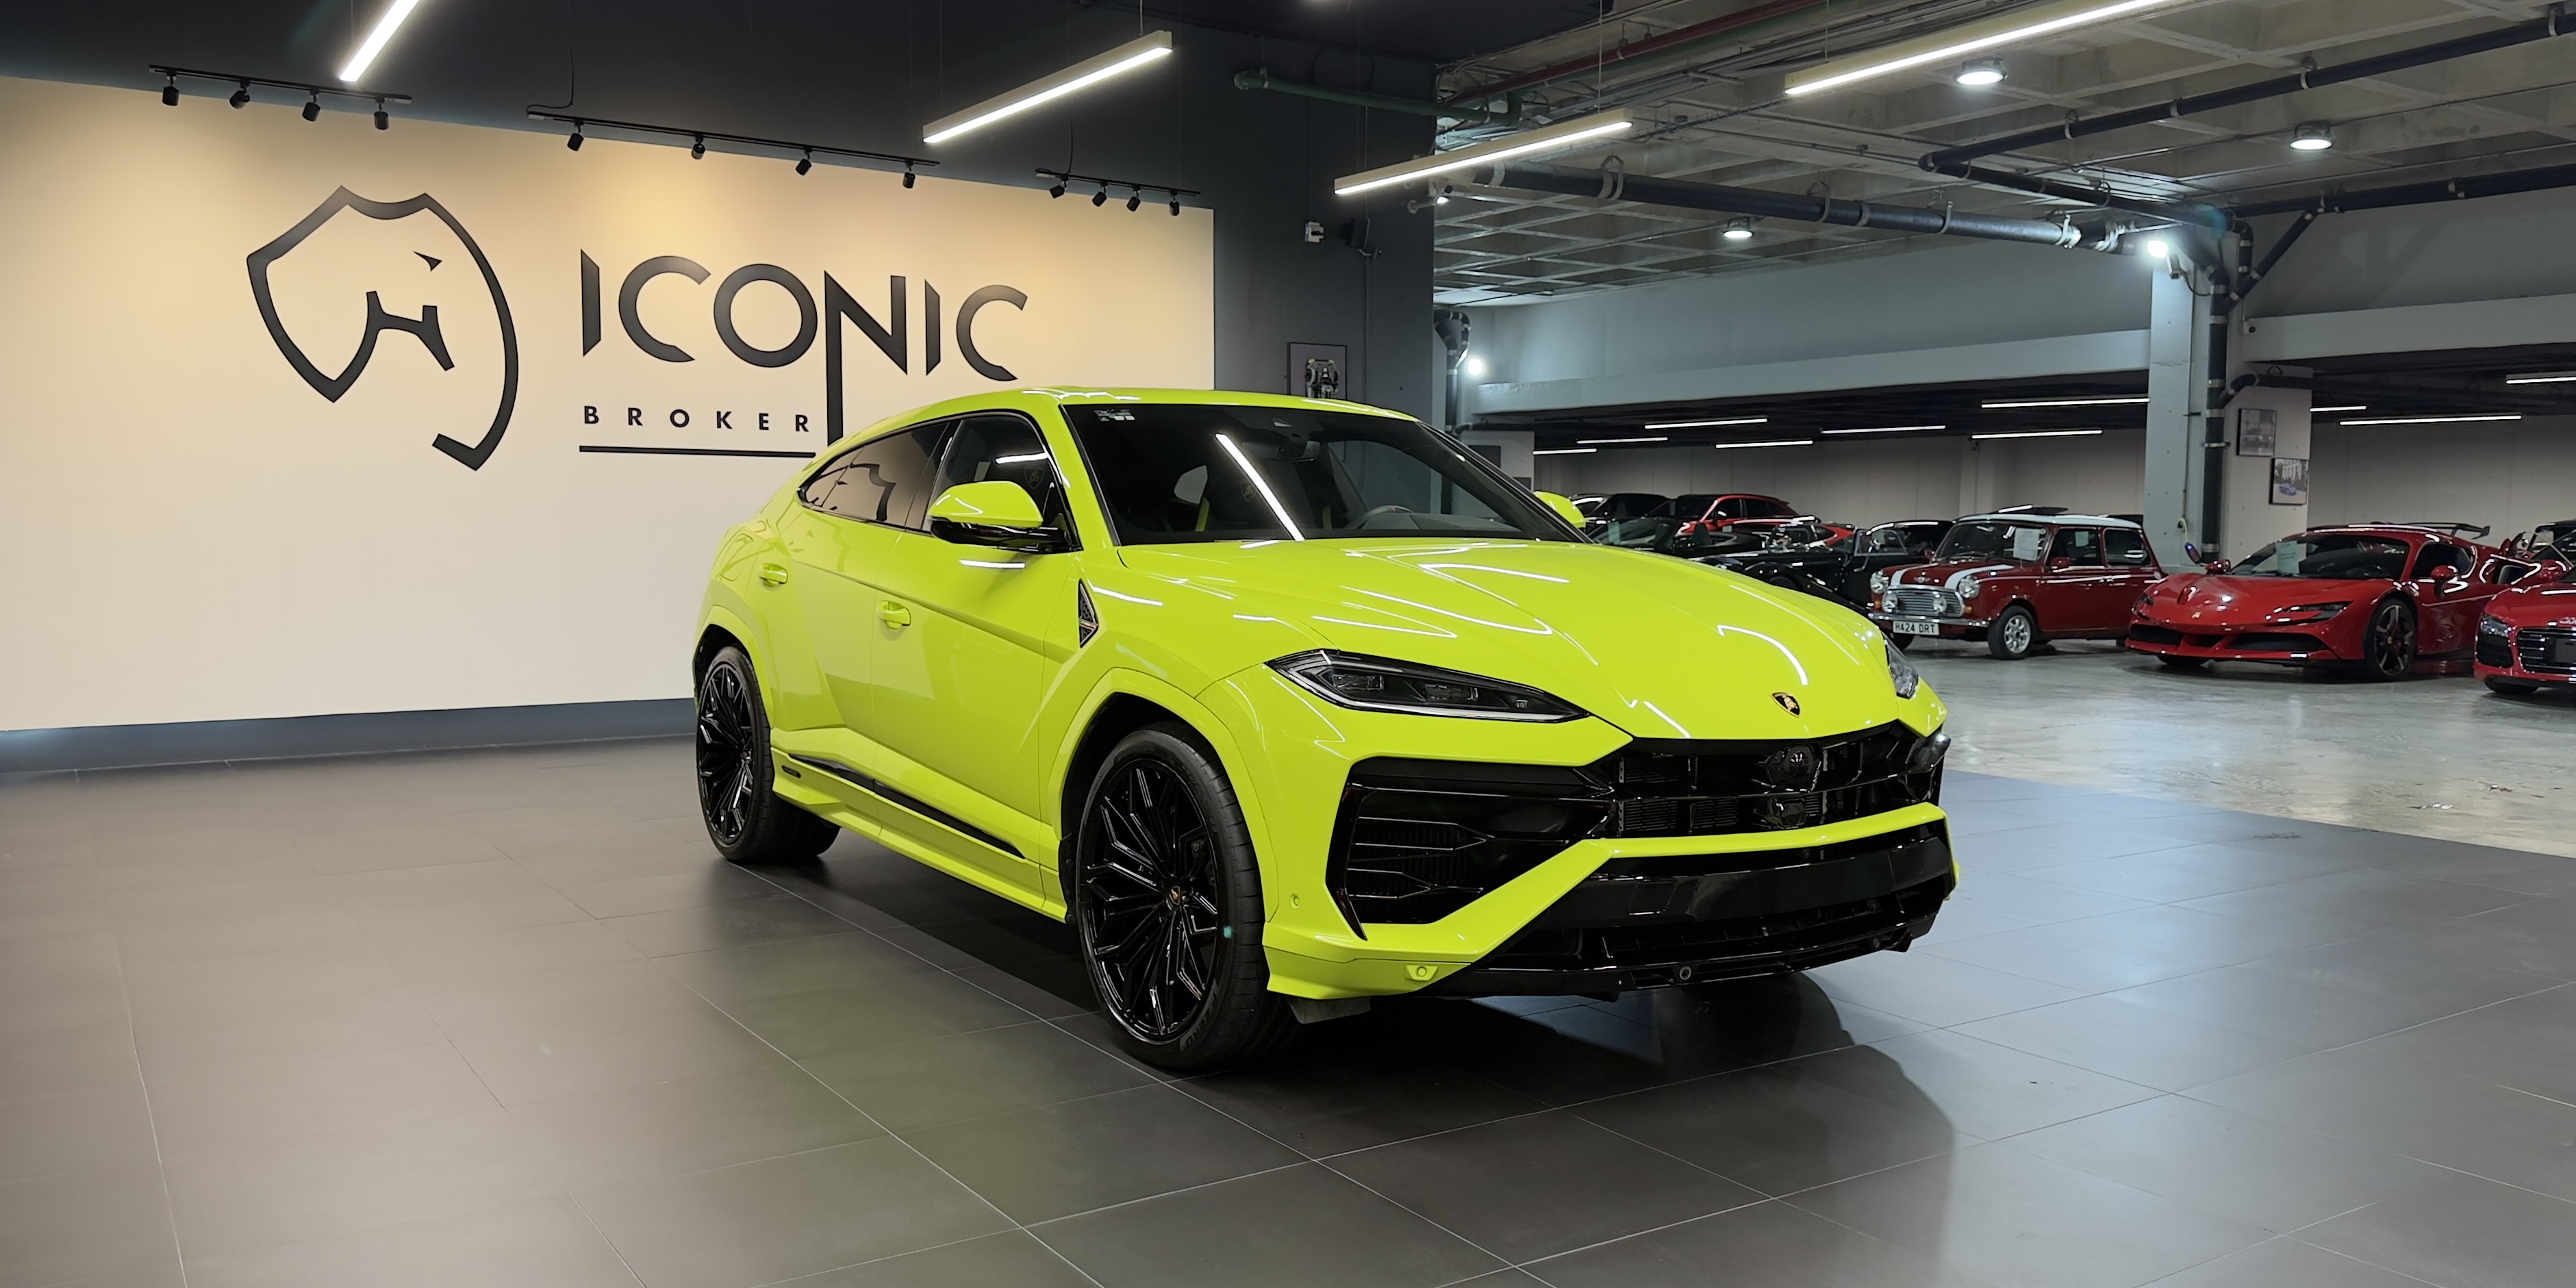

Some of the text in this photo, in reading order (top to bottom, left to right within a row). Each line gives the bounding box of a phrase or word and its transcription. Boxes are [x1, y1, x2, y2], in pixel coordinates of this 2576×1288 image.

[580, 248, 1028, 446] ICONIC
[583, 405, 810, 433] BROKER
[1895, 622, 1935, 633] H424 DRT
